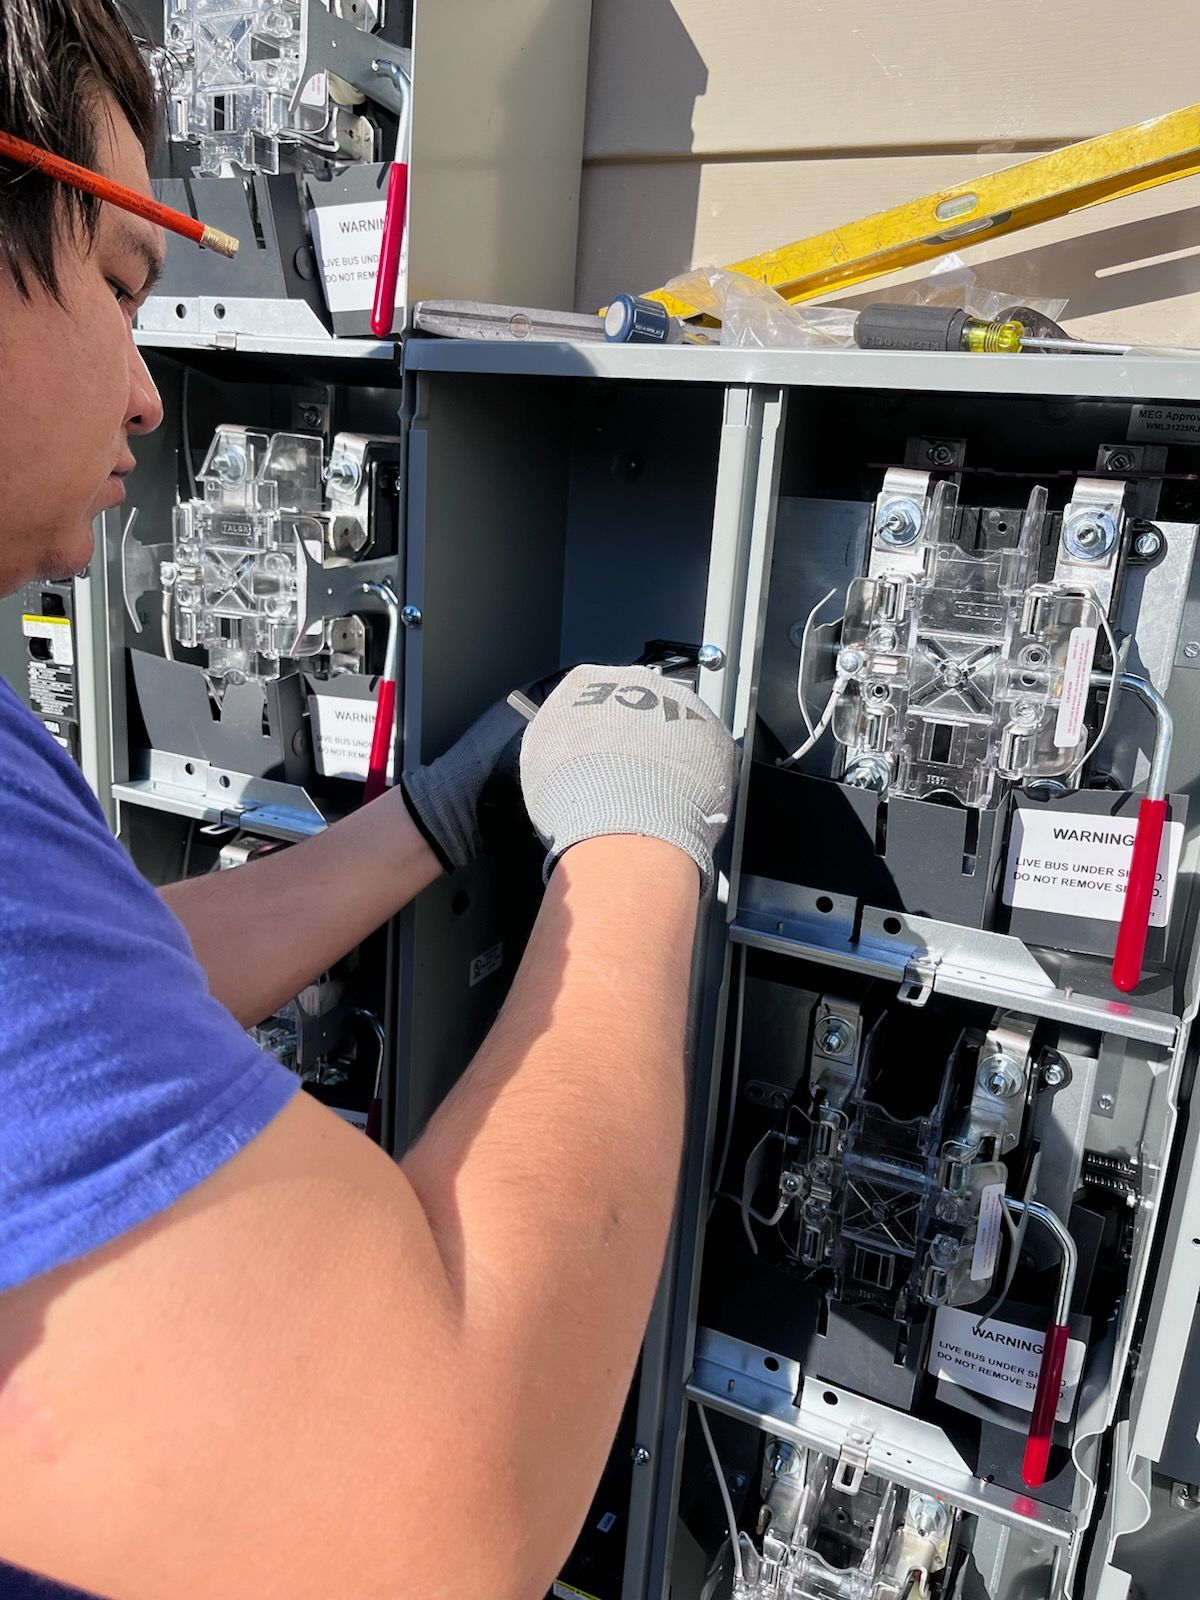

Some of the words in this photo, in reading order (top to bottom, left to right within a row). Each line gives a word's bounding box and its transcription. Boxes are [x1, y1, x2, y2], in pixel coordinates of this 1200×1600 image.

[338, 218, 387, 234] WARNIN
[342, 256, 360, 266] BUS
[360, 254, 379, 264] UND
[338, 272, 355, 281] NOT
[1138, 409, 1163, 419] MEG
[335, 711, 377, 724] WARNIN
[1053, 828, 1135, 846] WARNING
[1015, 857, 1041, 868] LIVE
[1045, 861, 1069, 871] BUS
[1072, 864, 1114, 876] UNDER
[1013, 872, 1030, 882] DO
[1034, 875, 1058, 885] NOT
[1061, 878, 1113, 892] REMOVE
[972, 1325, 1044, 1355] WARNING
[939, 1340, 962, 1354] LIVE
[964, 1349, 985, 1362] BUS
[988, 1358, 1025, 1375] UNDER
[937, 1351, 952, 1361] DO
[954, 1357, 976, 1370] NOT
[978, 1365, 1022, 1386] REMOVE
